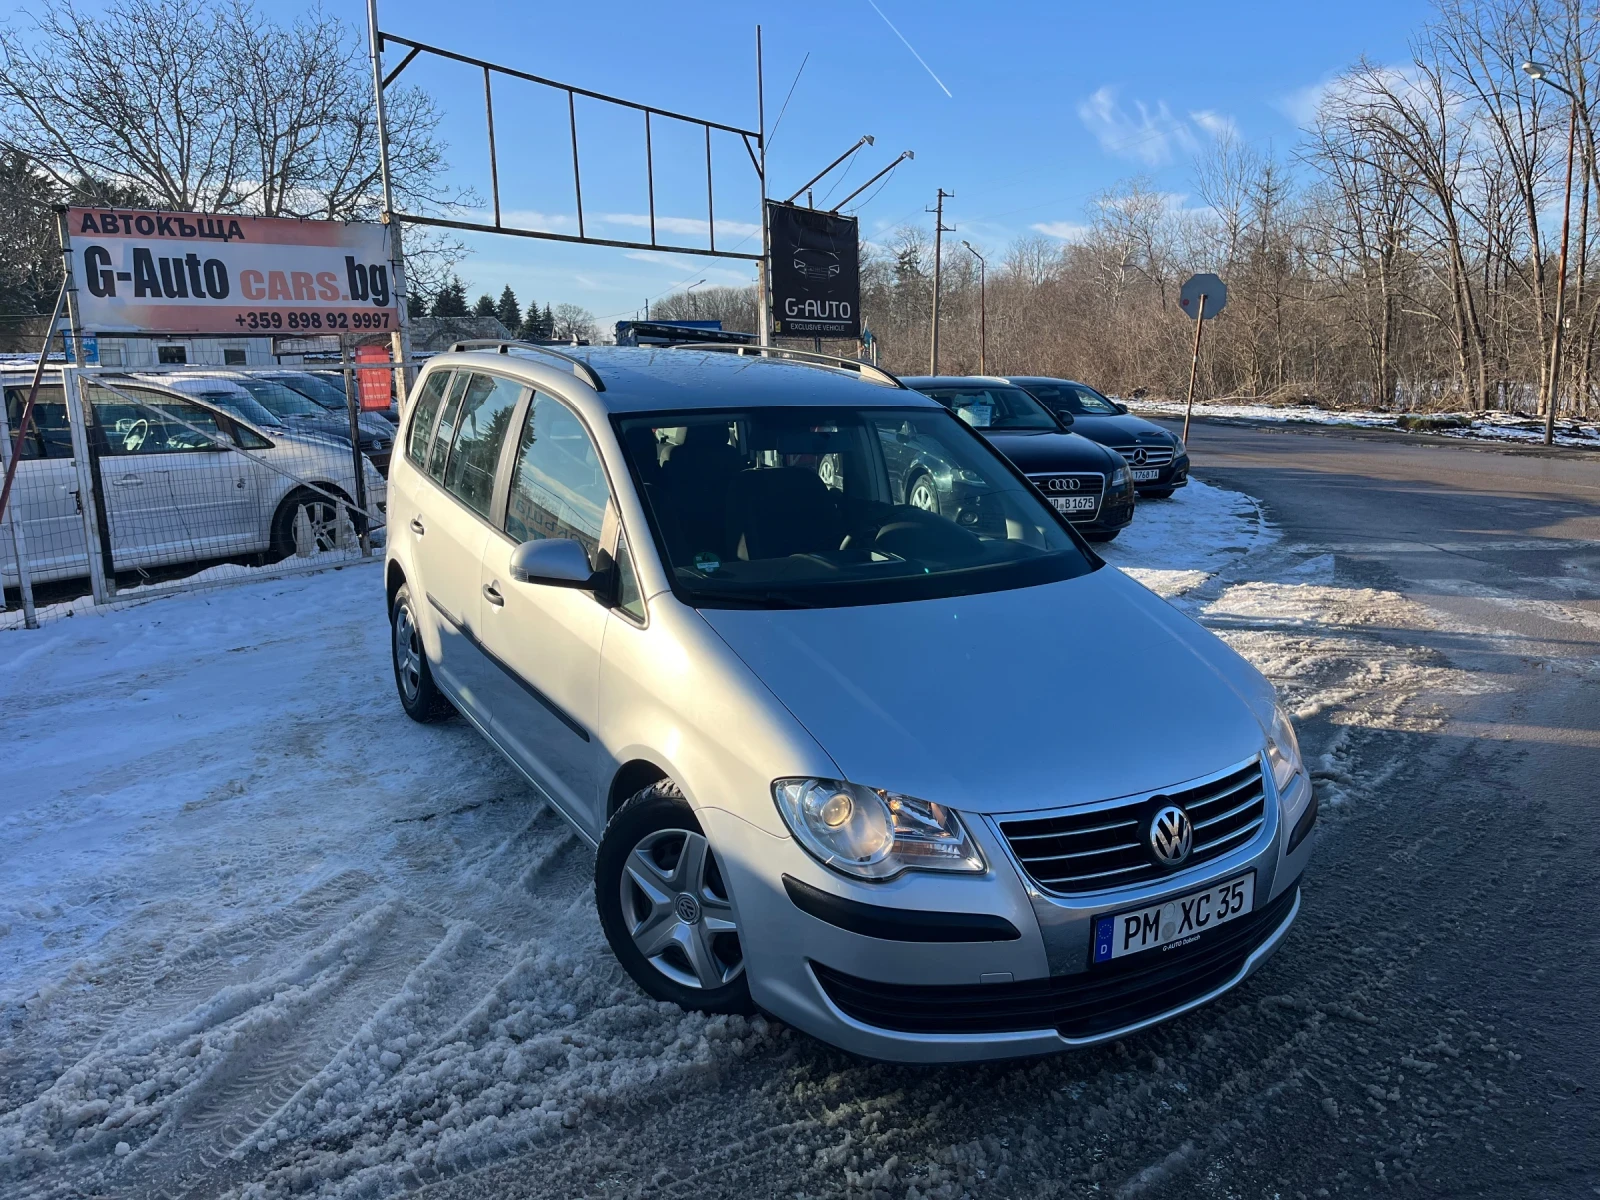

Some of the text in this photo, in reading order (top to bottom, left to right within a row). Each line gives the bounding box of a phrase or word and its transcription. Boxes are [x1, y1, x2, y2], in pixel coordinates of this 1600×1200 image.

[80, 212, 246, 243] АВТОКЪЩА
[84, 245, 231, 300] G-Auto
[785, 297, 851, 319] G-AUTO
[235, 312, 390, 329] +359 898 92 9997
[790, 322, 846, 332] EXCLUSIVE VEHICLE
[1072, 497, 1094, 509] 1675
[1123, 880, 1245, 950] PM XC 35
[1100, 944, 1108, 955] D
